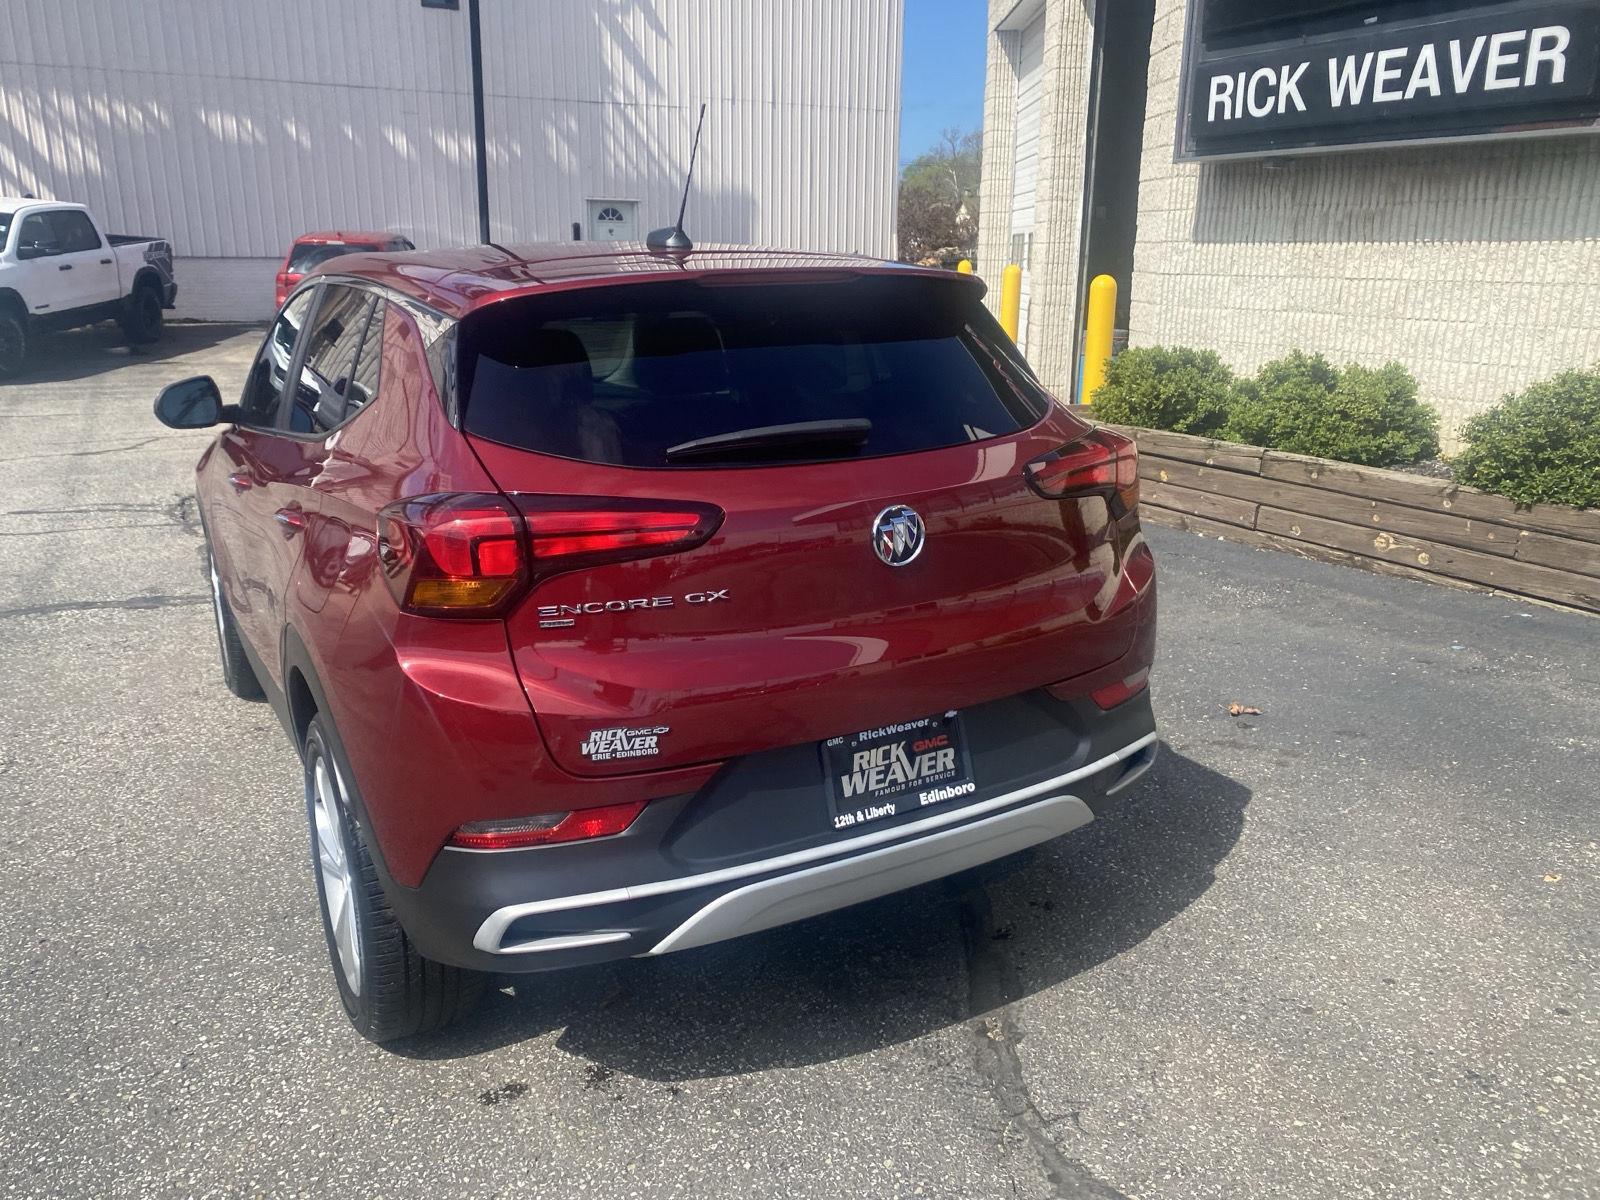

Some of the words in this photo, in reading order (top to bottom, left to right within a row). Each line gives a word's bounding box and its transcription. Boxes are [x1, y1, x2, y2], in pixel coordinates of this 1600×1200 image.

[1207, 61, 1310, 122] RICK
[1328, 25, 1571, 108] WEAVER
[537, 596, 674, 617] ENCORE
[684, 588, 729, 603] GX
[589, 728, 628, 743] RICK
[626, 728, 652, 737] GMC
[827, 736, 844, 747] GMC
[859, 718, 930, 742] RickWeaver
[581, 735, 658, 755] WEAVER
[592, 752, 611, 761] ERIE
[616, 747, 659, 759] EDINBORO
[912, 734, 949, 752] GMC
[852, 741, 906, 772] RICK
[841, 747, 956, 798] WEAVER
[874, 784, 906, 798] FAMOUS
[908, 778, 923, 788] FOR
[925, 770, 956, 784] SERVICE
[919, 782, 976, 806] Edinboro
[834, 812, 856, 829] 12th
[856, 811, 865, 822] &
[864, 803, 896, 820] Liberty
